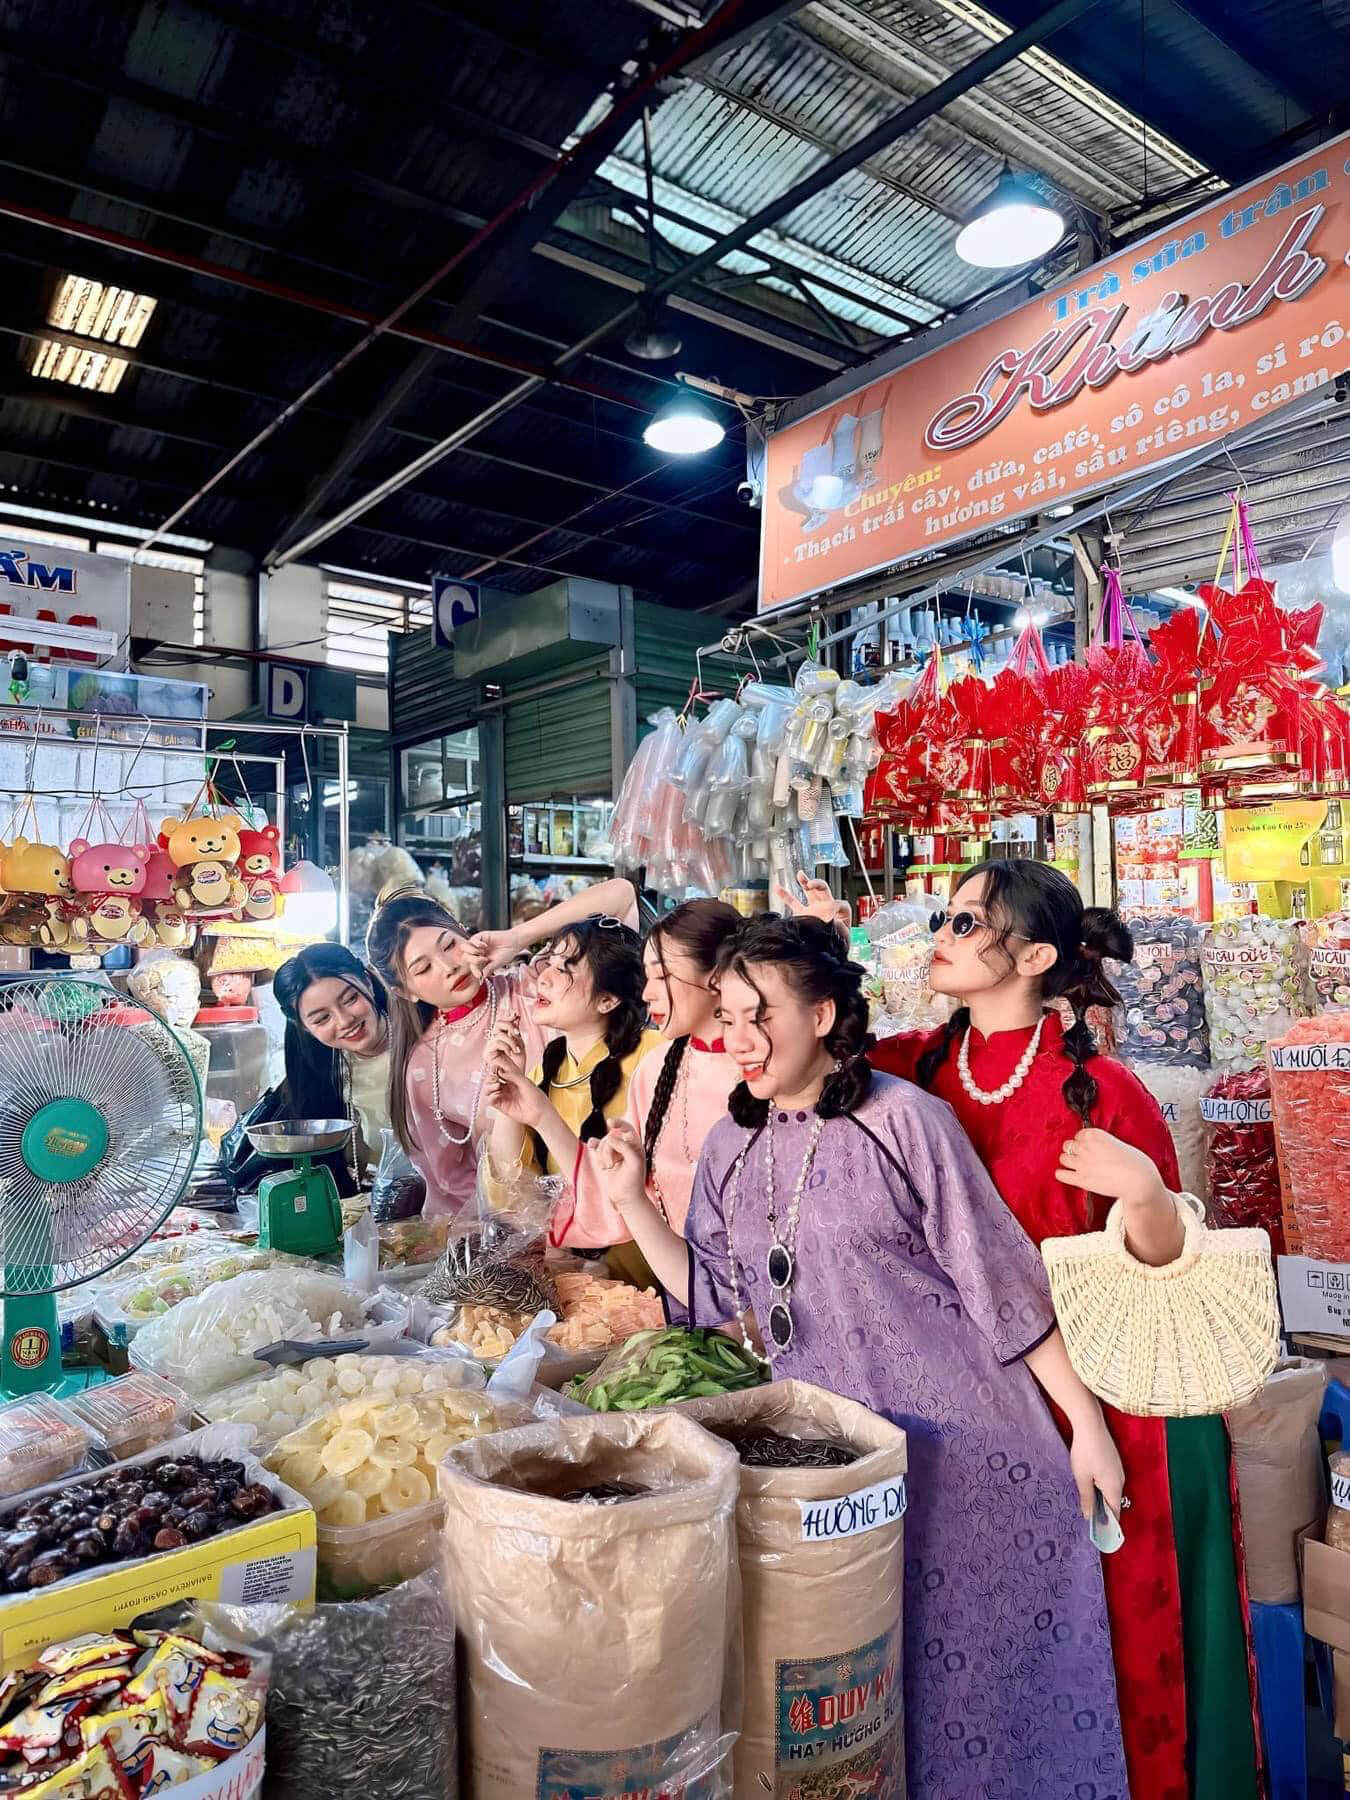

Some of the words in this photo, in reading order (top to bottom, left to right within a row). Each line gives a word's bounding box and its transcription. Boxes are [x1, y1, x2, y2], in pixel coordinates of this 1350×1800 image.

[1219, 169, 1331, 239] trân
[1135, 404, 1241, 456] riêng,
[794, 526, 857, 563] Thạch
[863, 500, 906, 535] trái
[912, 485, 962, 515] cây,
[1033, 425, 1100, 466] café,
[1111, 402, 1145, 433] sô
[1153, 383, 1191, 416] cô
[1200, 371, 1246, 399] la,
[437, 584, 479, 647] C
[271, 667, 304, 716] D
